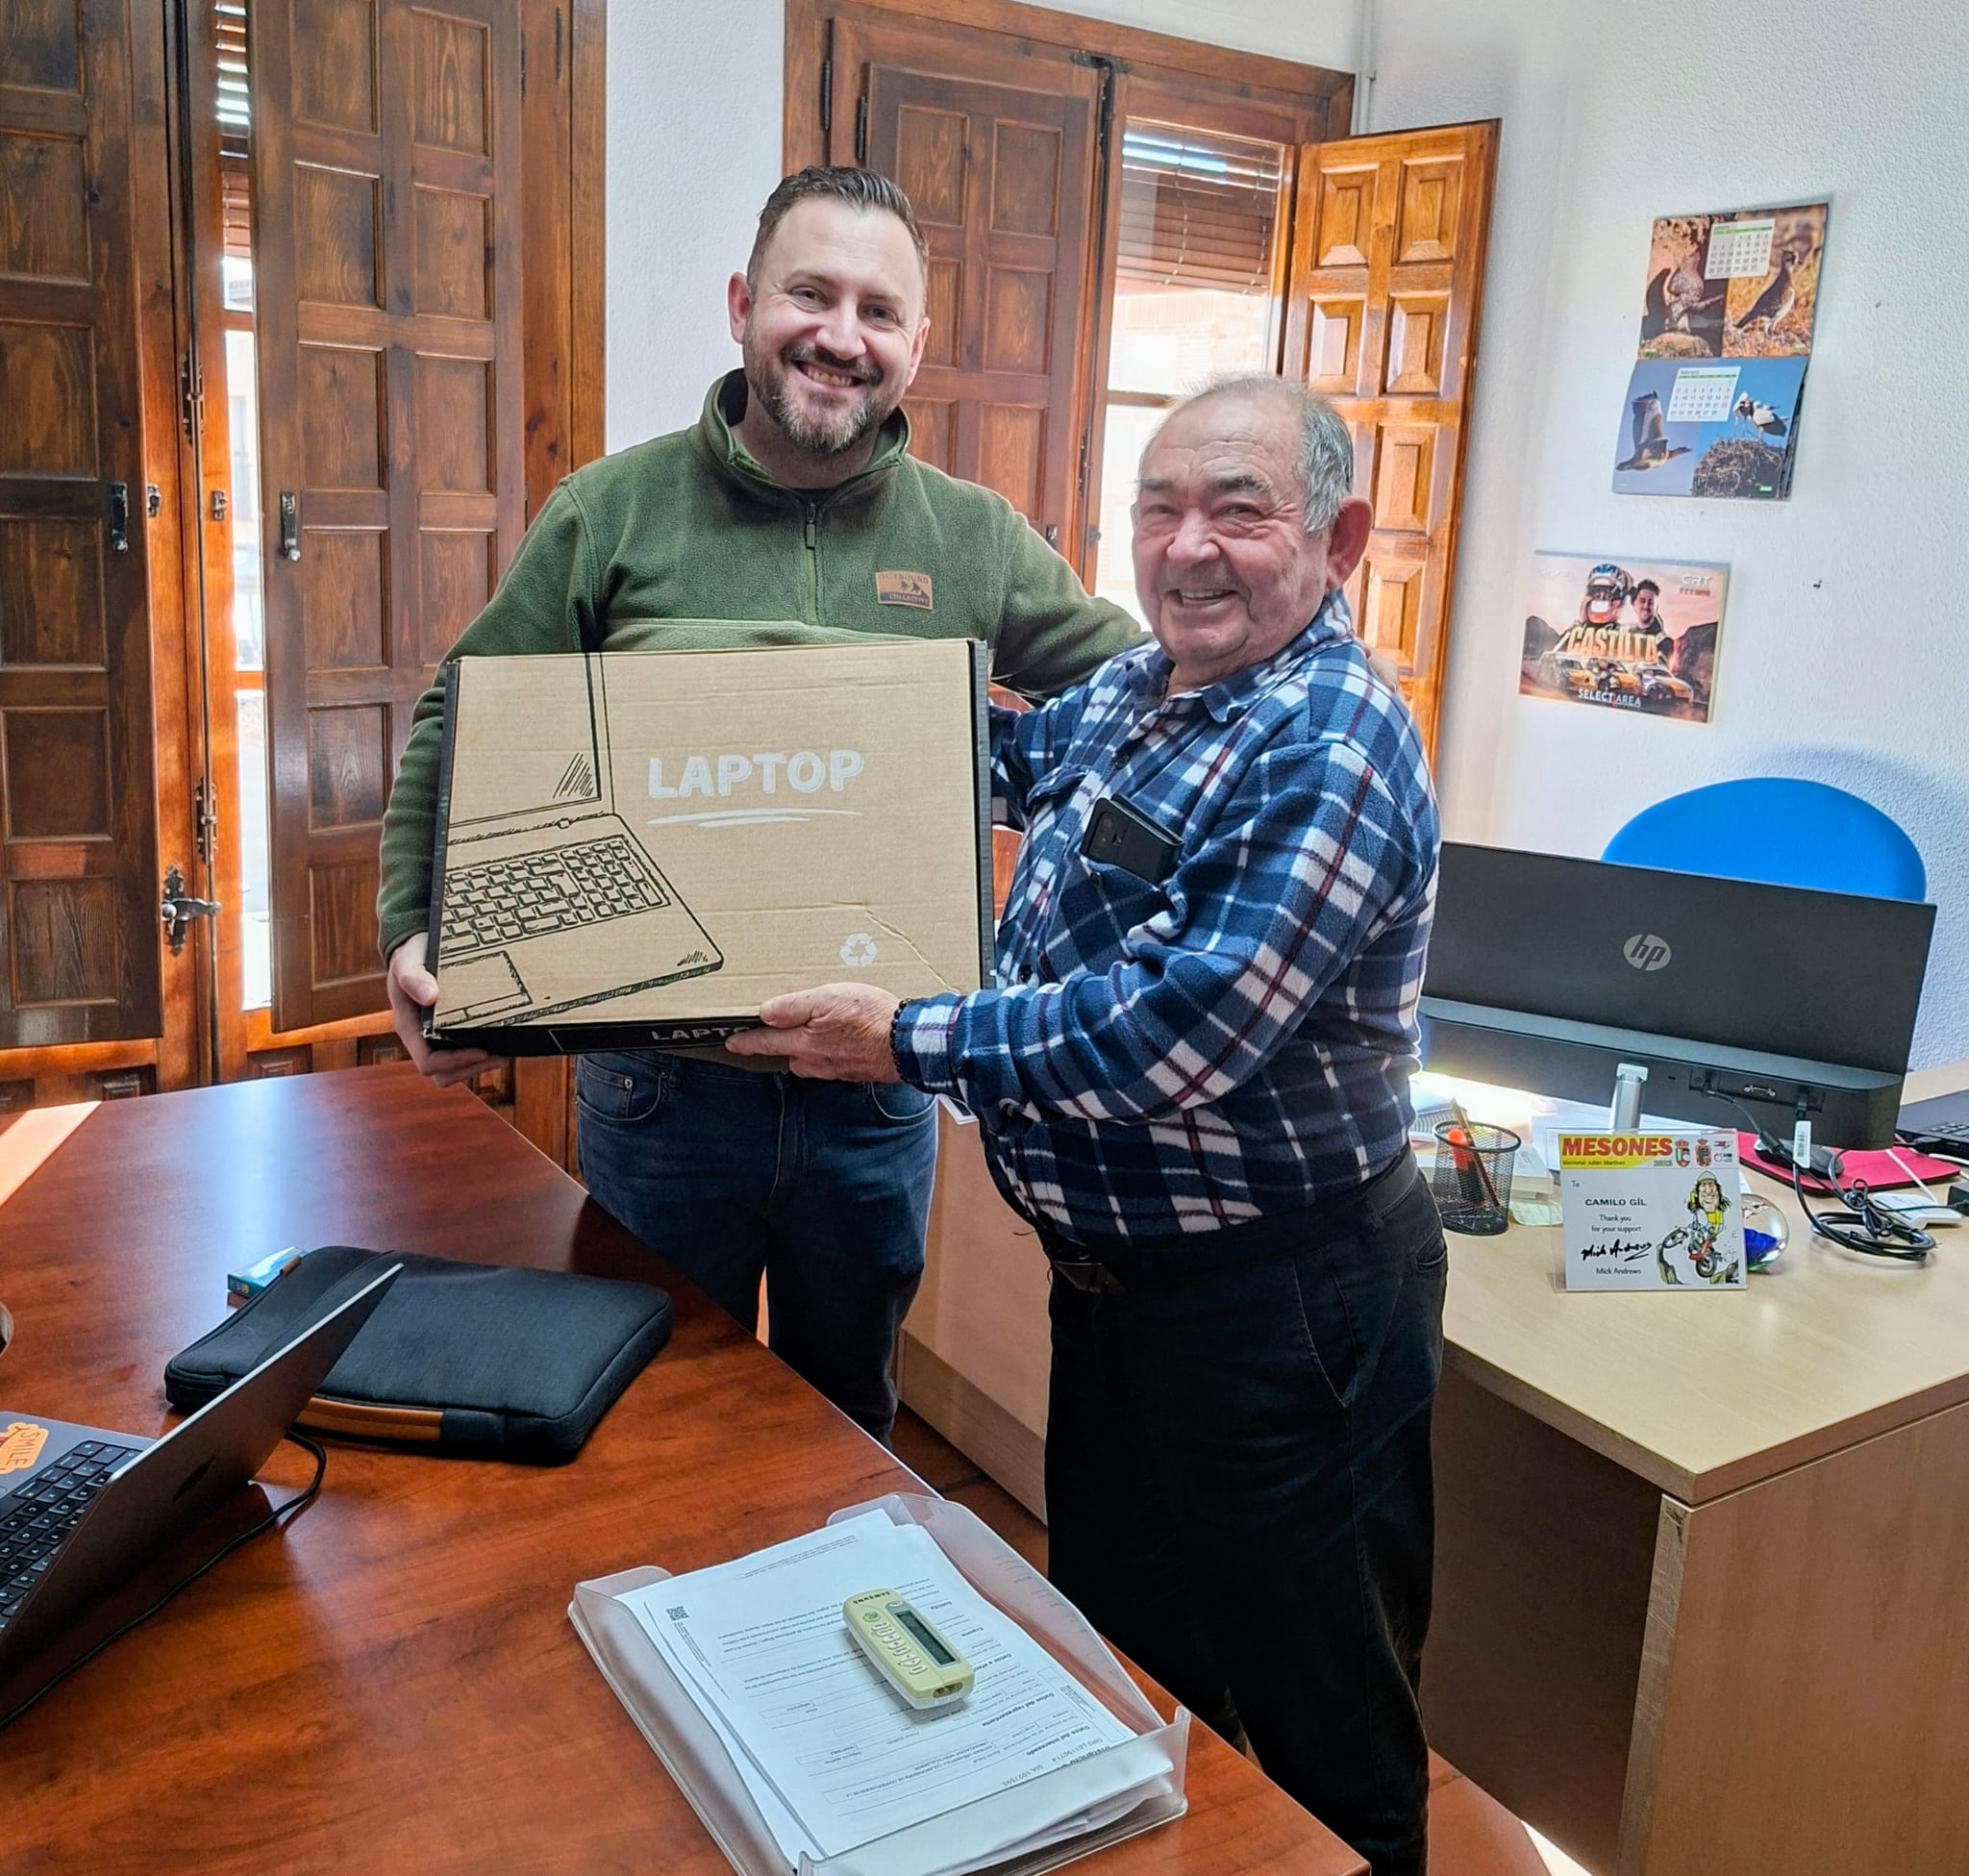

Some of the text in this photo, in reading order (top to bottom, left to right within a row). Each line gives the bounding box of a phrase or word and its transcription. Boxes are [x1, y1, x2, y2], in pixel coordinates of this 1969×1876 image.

[879, 573, 929, 584] OUTBOUND
[1681, 574, 1712, 586] CRT
[889, 593, 928, 604] COLLECTIVE
[1578, 688, 1641, 708] SELECT AREA
[649, 750, 864, 799] LAPTOP
[1630, 934, 1666, 970] hp
[1562, 1137, 1673, 1156] MESONES
[6, 1431, 40, 1466] SMILE
[851, 1586, 890, 1609] SAMSUNG
[929, 1599, 952, 1612] Solicita
[960, 1625, 984, 1639] Expone
[993, 1652, 1012, 1664] Datos
[980, 1691, 1054, 1727] Datos del representante
[1025, 1723, 1090, 1757] Datos del interesado
[1030, 1763, 1043, 1773] SIA
